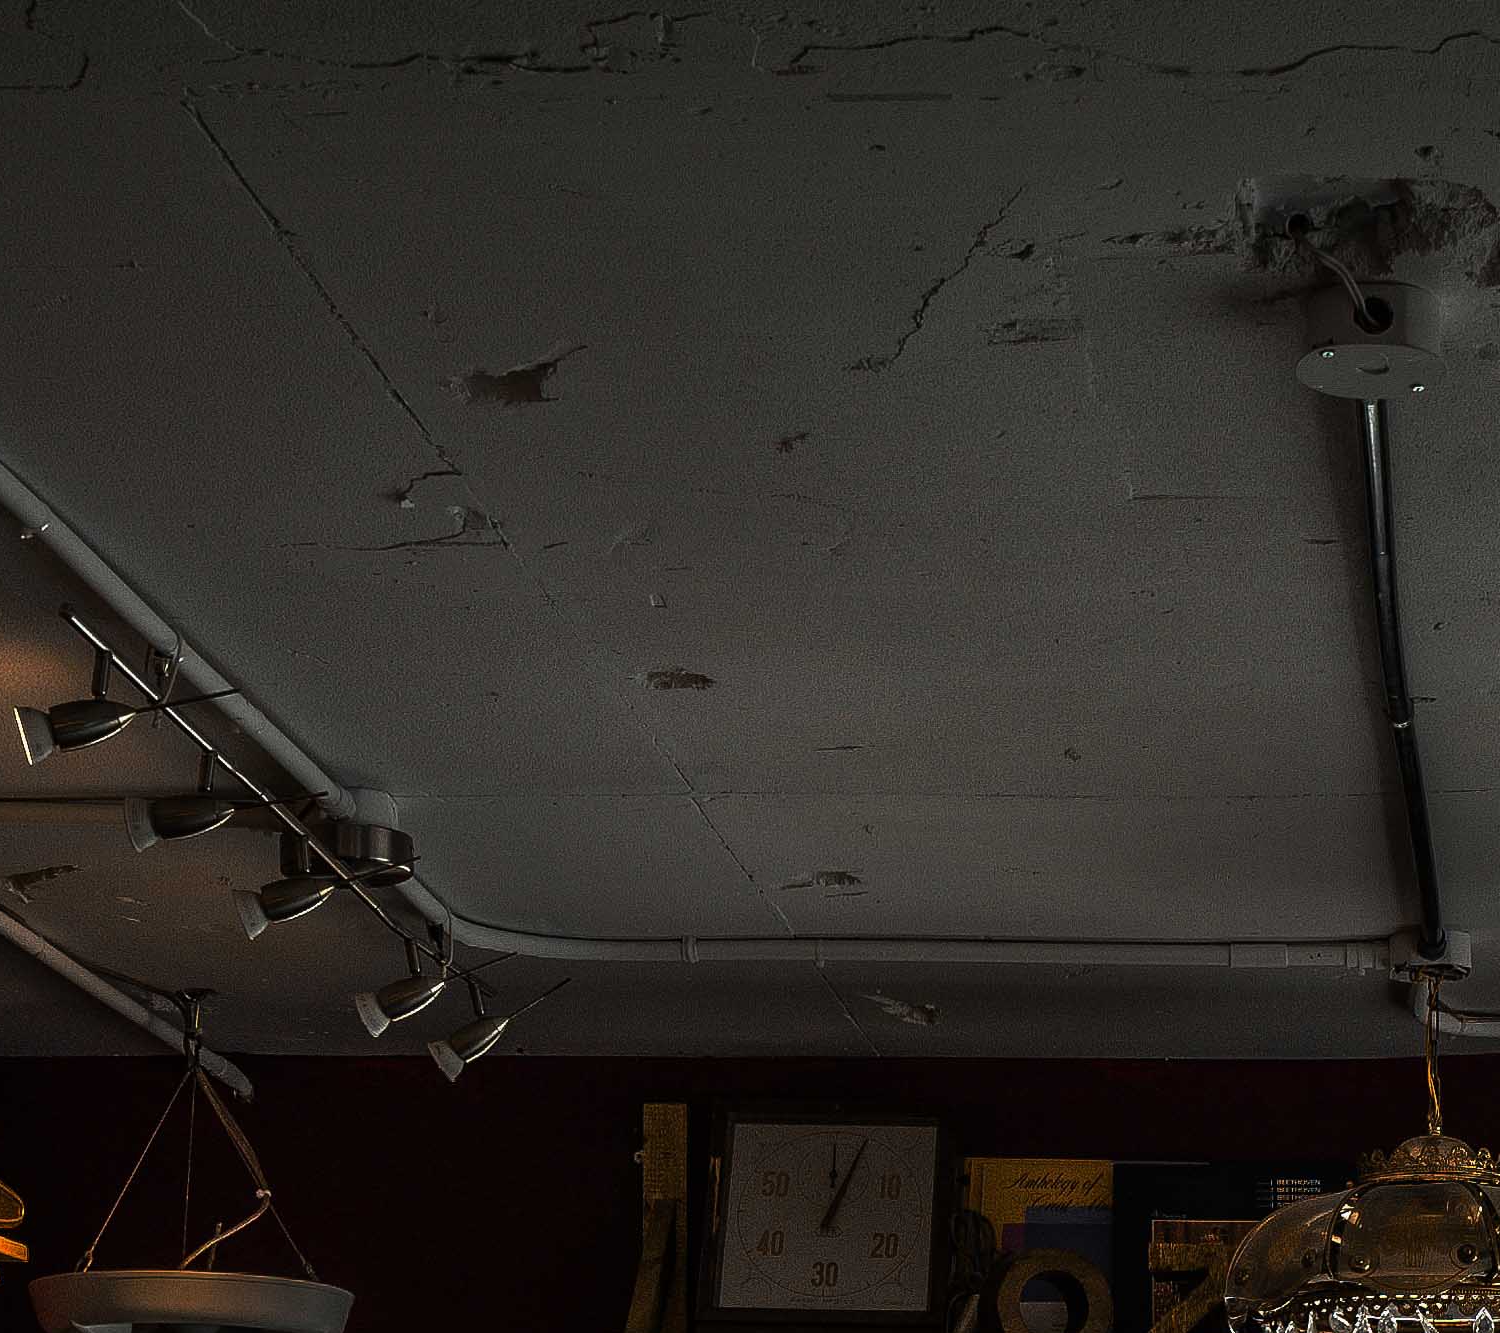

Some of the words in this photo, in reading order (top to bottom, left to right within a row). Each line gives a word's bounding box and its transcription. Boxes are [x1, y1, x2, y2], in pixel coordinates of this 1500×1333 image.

[761, 1171, 790, 1197] 50
[881, 1174, 901, 1200] 10
[1005, 1173, 1079, 1193] Anthology
[1082, 1173, 1105, 1194] of
[756, 1229, 785, 1257] 40
[870, 1232, 899, 1259] 20
[810, 1261, 839, 1288] 30
